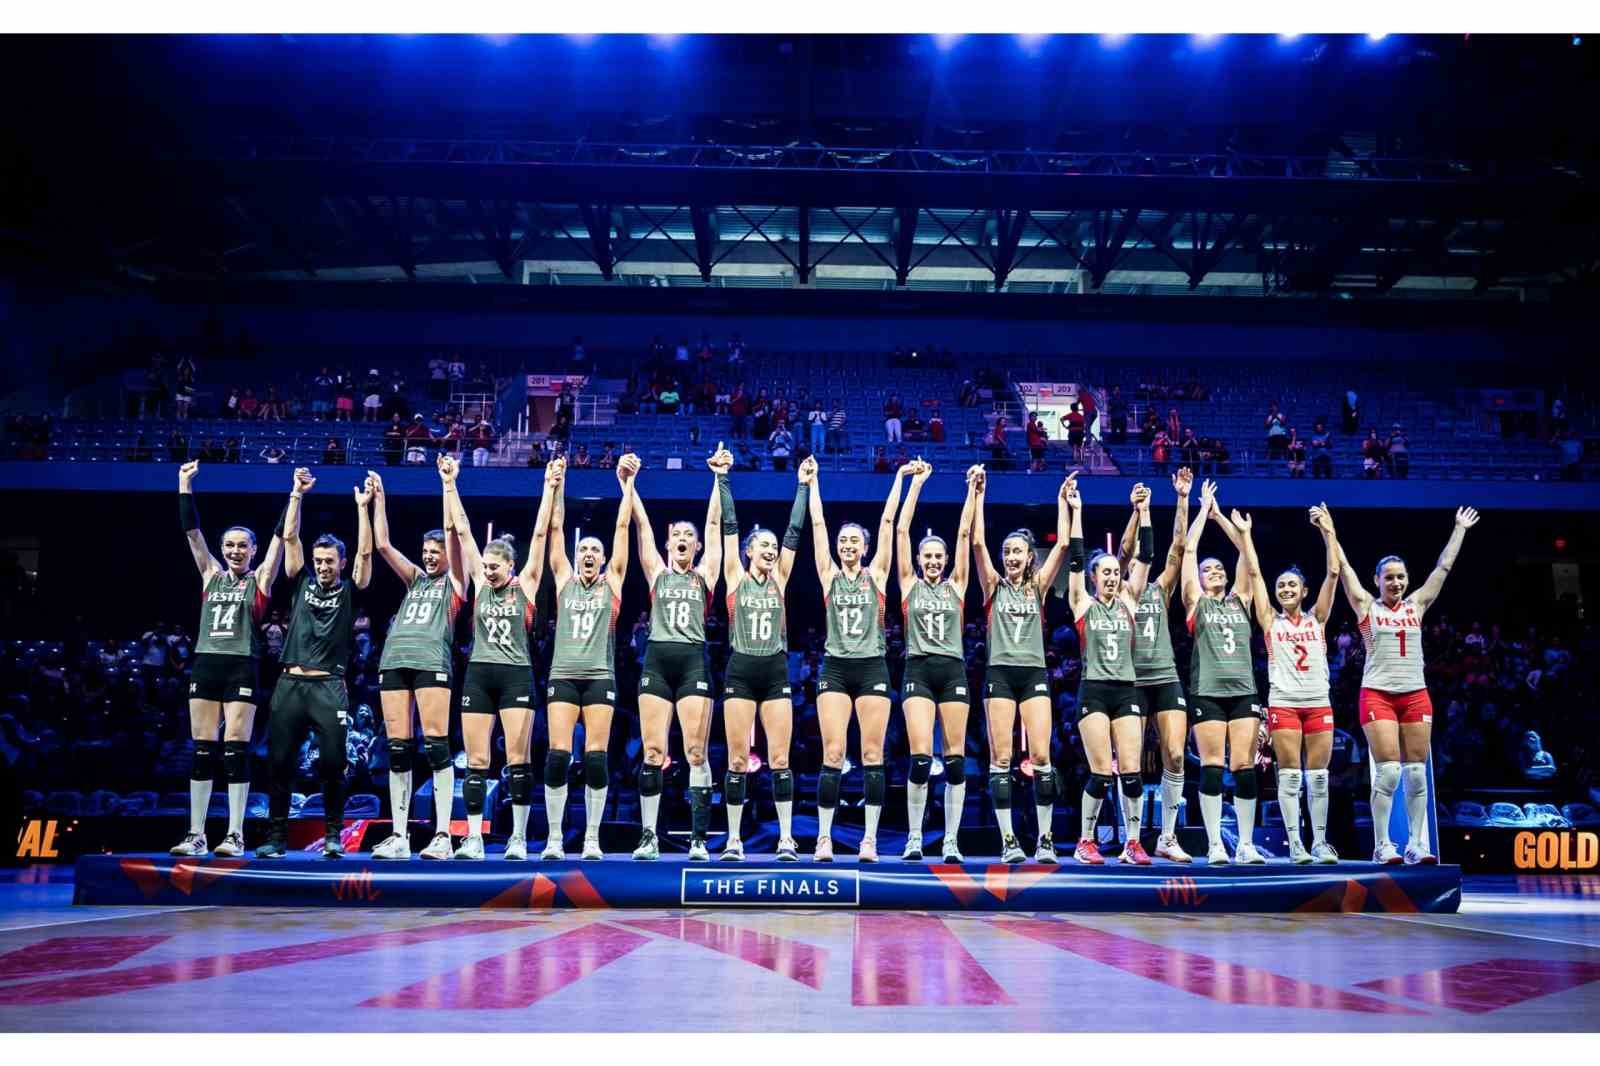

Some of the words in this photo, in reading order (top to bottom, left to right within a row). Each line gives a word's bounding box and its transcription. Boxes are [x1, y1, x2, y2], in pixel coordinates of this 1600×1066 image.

[564, 597, 606, 611] VESTEL
[659, 588, 703, 602] VESTEL
[741, 596, 781, 610] VESTEL
[832, 593, 873, 606] VESTEL
[914, 598, 954, 611] VESTEL
[210, 604, 239, 630] 14
[403, 602, 432, 625] 99
[666, 601, 690, 628] 18
[997, 602, 1039, 615] VESTEL
[1205, 612, 1248, 625] VESTEL
[485, 618, 512, 645] 22
[570, 612, 594, 640] 19
[748, 611, 772, 640] 16
[839, 607, 864, 636] 12
[923, 612, 946, 641] 11
[1011, 616, 1025, 643] 7
[1090, 618, 1131, 632] VESTEL
[1143, 616, 1155, 642] 4
[1106, 634, 1119, 661] 5
[1222, 628, 1236, 654] 3
[1277, 631, 1319, 643] VESTEL
[1395, 630, 1406, 657] 1
[1293, 644, 1312, 672] 2
[819, 681, 829, 690] 12
[906, 682, 915, 692] 11
[1271, 713, 1278, 724] 2
[1368, 711, 1376, 721] 1
[1514, 831, 1599, 869] GOLD
[332, 867, 381, 901] VNL
[703, 879, 745, 895] THE
[758, 879, 839, 895] FINALS
